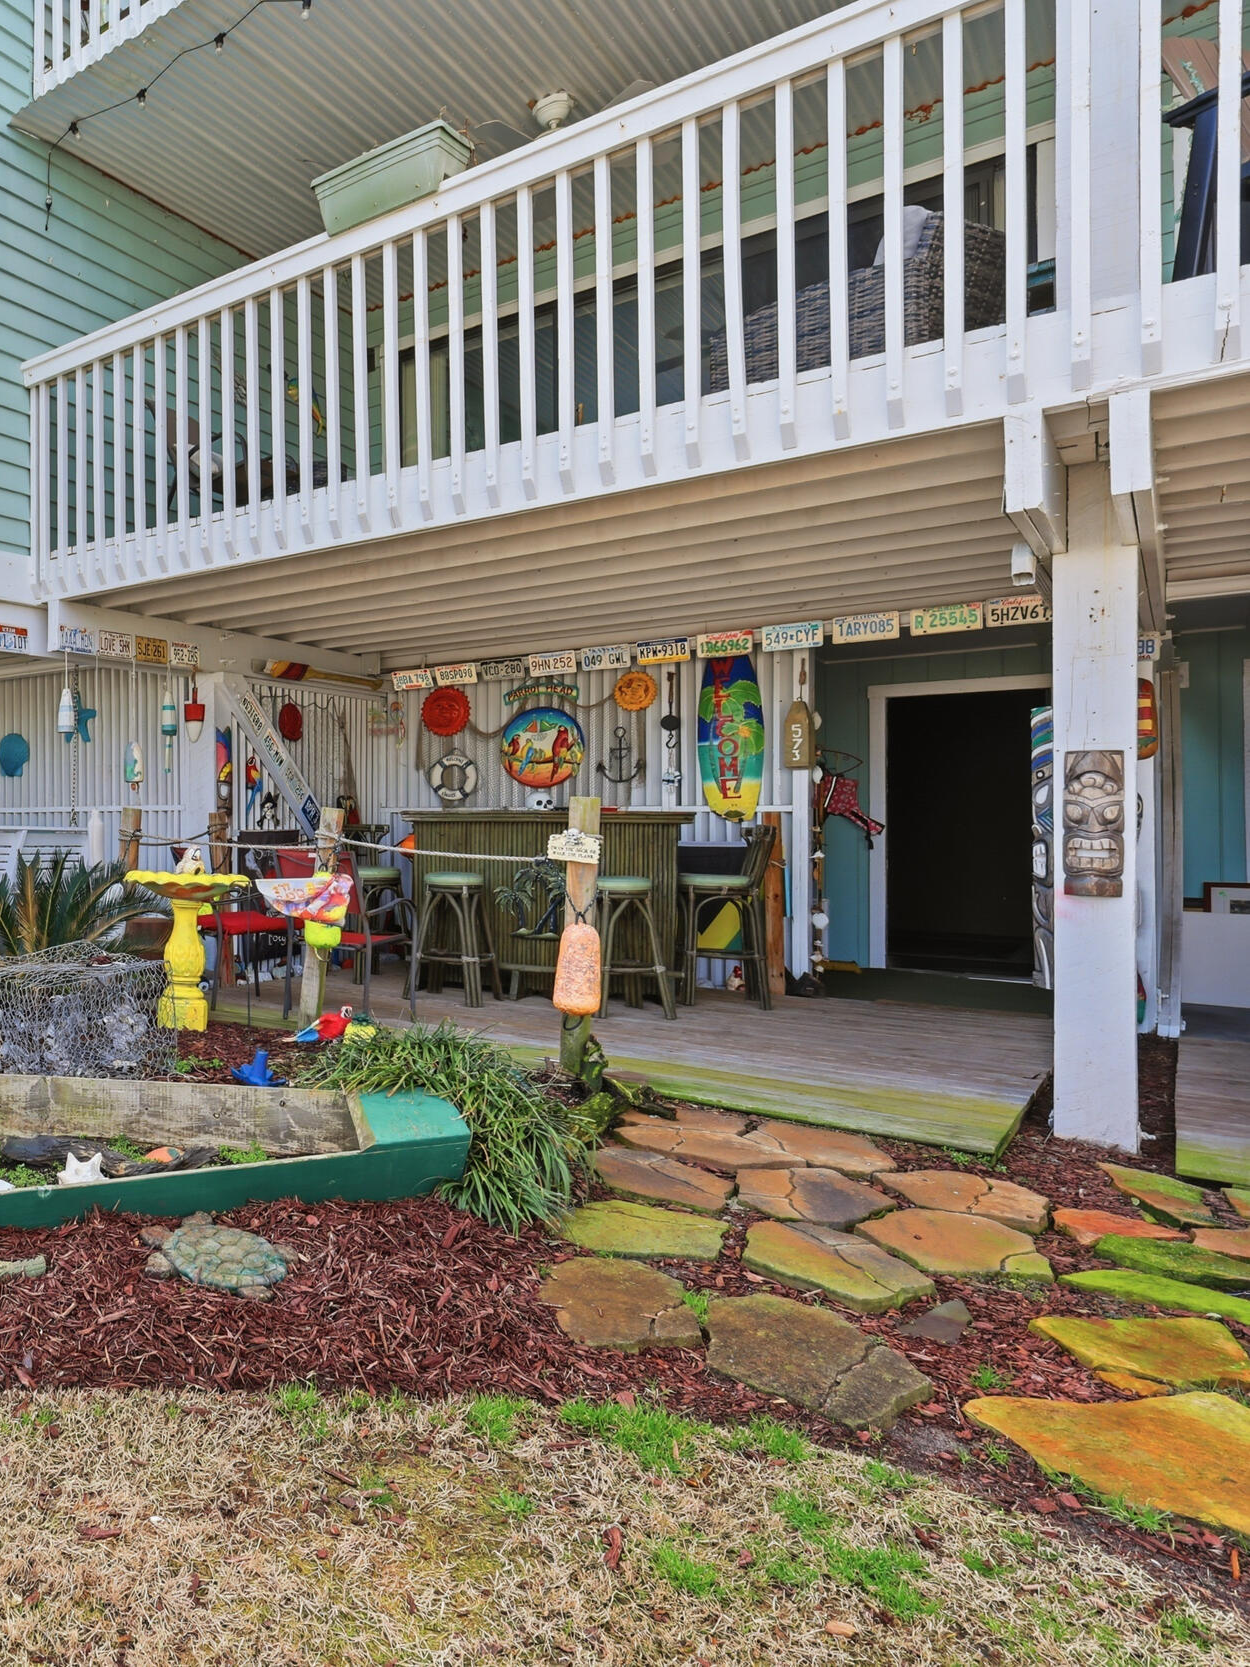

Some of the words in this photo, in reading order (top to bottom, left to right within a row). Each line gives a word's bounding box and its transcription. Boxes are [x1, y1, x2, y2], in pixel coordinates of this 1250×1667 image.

[546, 685, 574, 696] HEAD
[709, 656, 742, 800] WELCOME
[791, 723, 804, 761] 573
